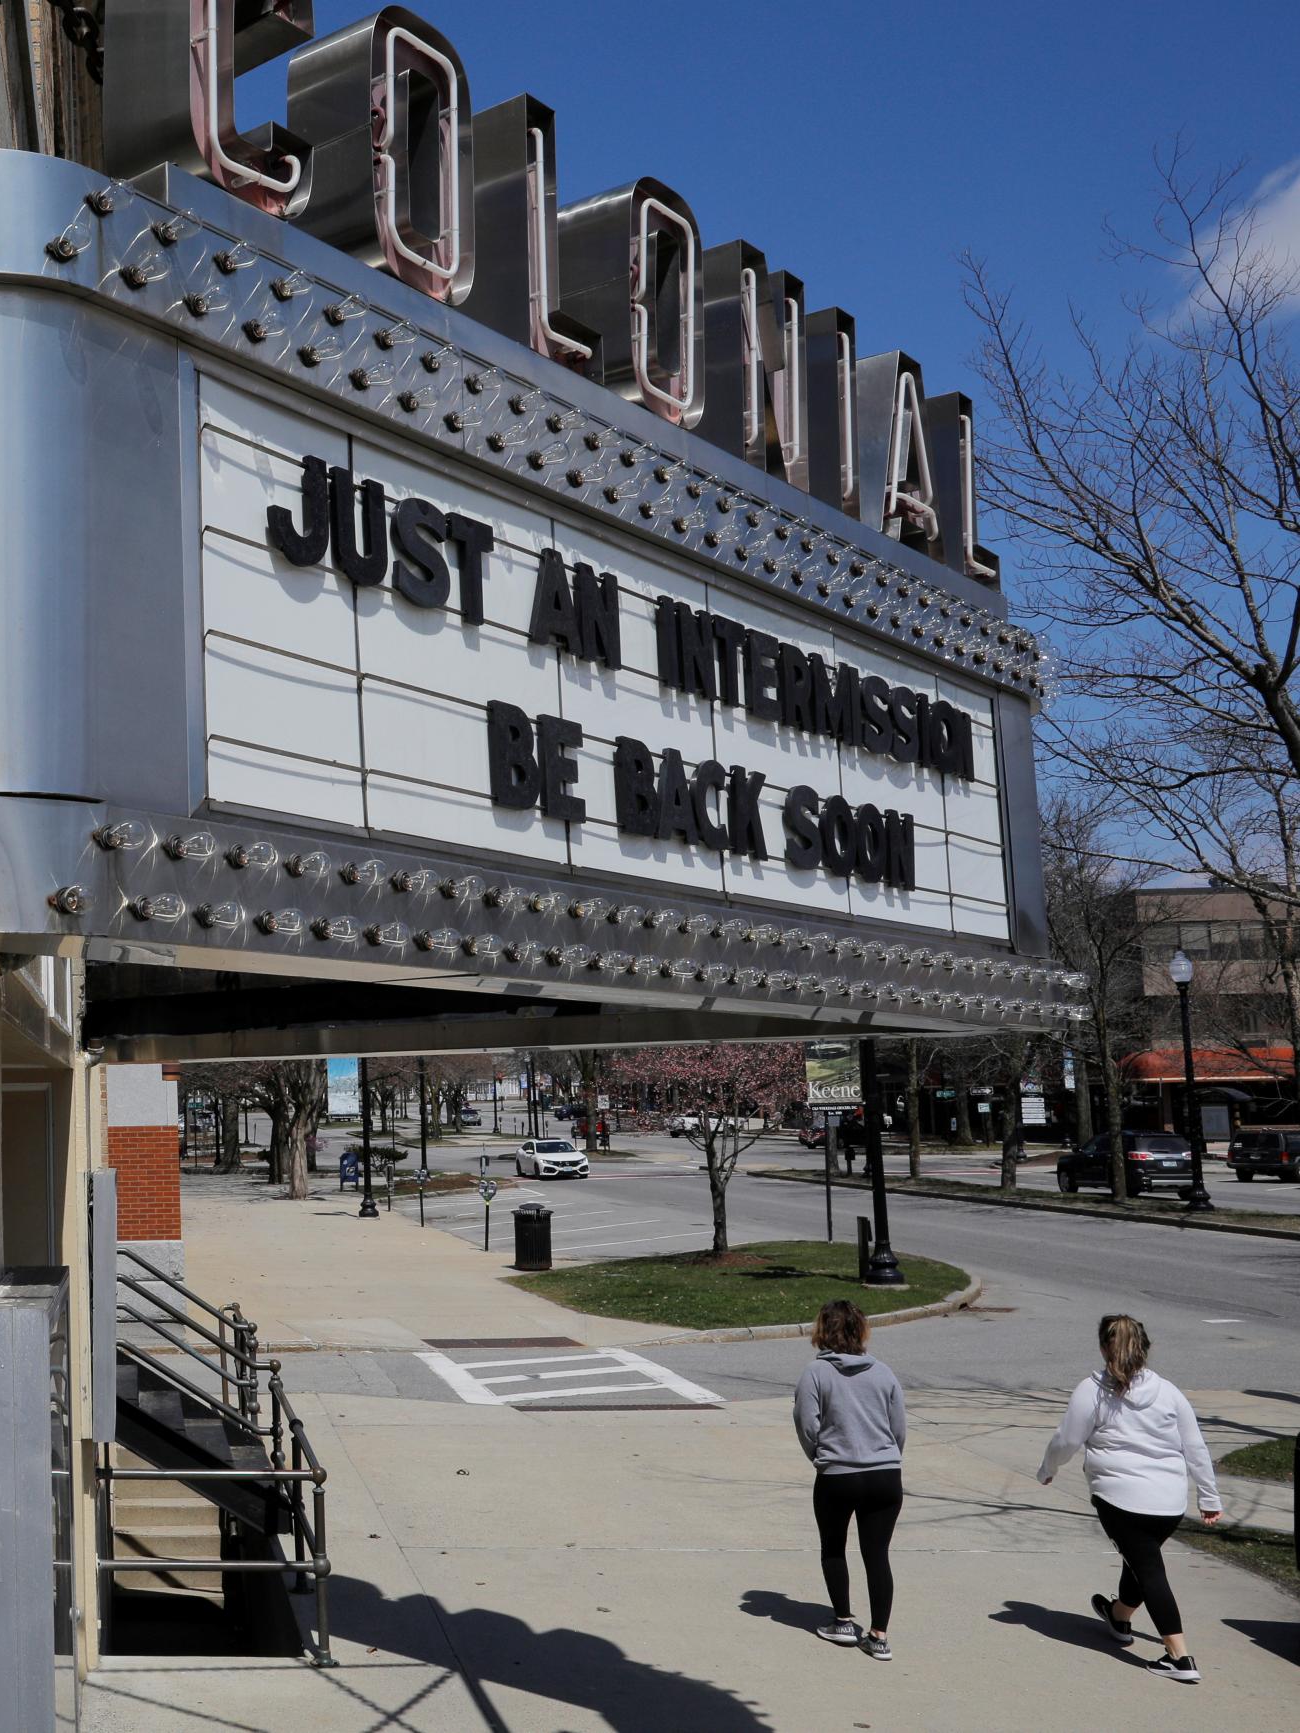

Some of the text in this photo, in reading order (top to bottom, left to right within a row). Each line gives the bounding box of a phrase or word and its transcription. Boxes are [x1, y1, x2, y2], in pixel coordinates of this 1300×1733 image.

[266, 455, 976, 783] JUST AN INTERMISSION
[487, 700, 917, 892] BE BACK SOON
[807, 1080, 862, 1098] Keene
